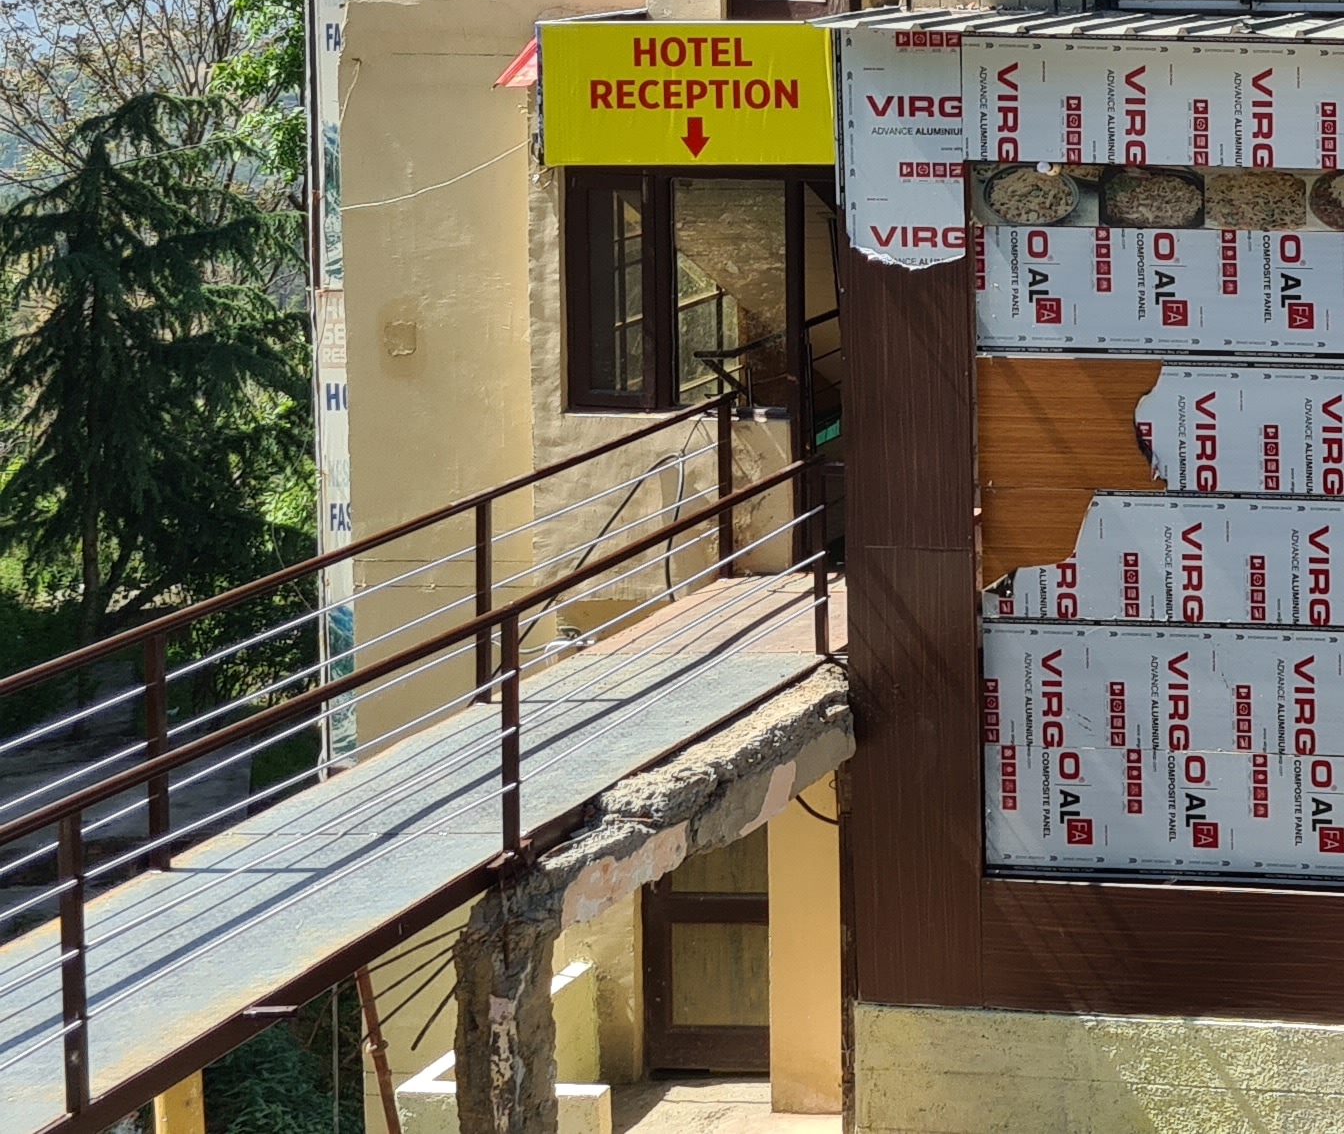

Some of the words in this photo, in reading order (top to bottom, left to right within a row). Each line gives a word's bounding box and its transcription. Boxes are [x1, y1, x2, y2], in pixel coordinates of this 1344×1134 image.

[633, 36, 753, 68] HOTEL
[589, 78, 799, 110] RECEPTION
[865, 95, 963, 118] VIRG
[997, 62, 1019, 163] VIRG
[1106, 68, 1116, 113] ADVANCE
[1125, 64, 1147, 167] VIRG
[871, 126, 914, 136] ADVANCE
[1252, 67, 1274, 170] VIRG
[870, 226, 966, 248] VIRG
[1136, 234, 1146, 288] COMPOSITE
[1136, 289, 1146, 321] PANEL
[1196, 392, 1218, 492] VIRG
[1304, 397, 1314, 441] ADVANCE
[1322, 394, 1344, 496] VIRG
[1182, 522, 1204, 623] VIRG
[1309, 525, 1331, 627] VIRG
[1042, 649, 1064, 748] VIRG
[1150, 655, 1160, 698] ADVANCE
[1168, 652, 1190, 752] VIRG
[1294, 655, 1316, 756] VIRG
[1167, 756, 1177, 810] COMPOSITE
[1167, 811, 1177, 843] PANEL
